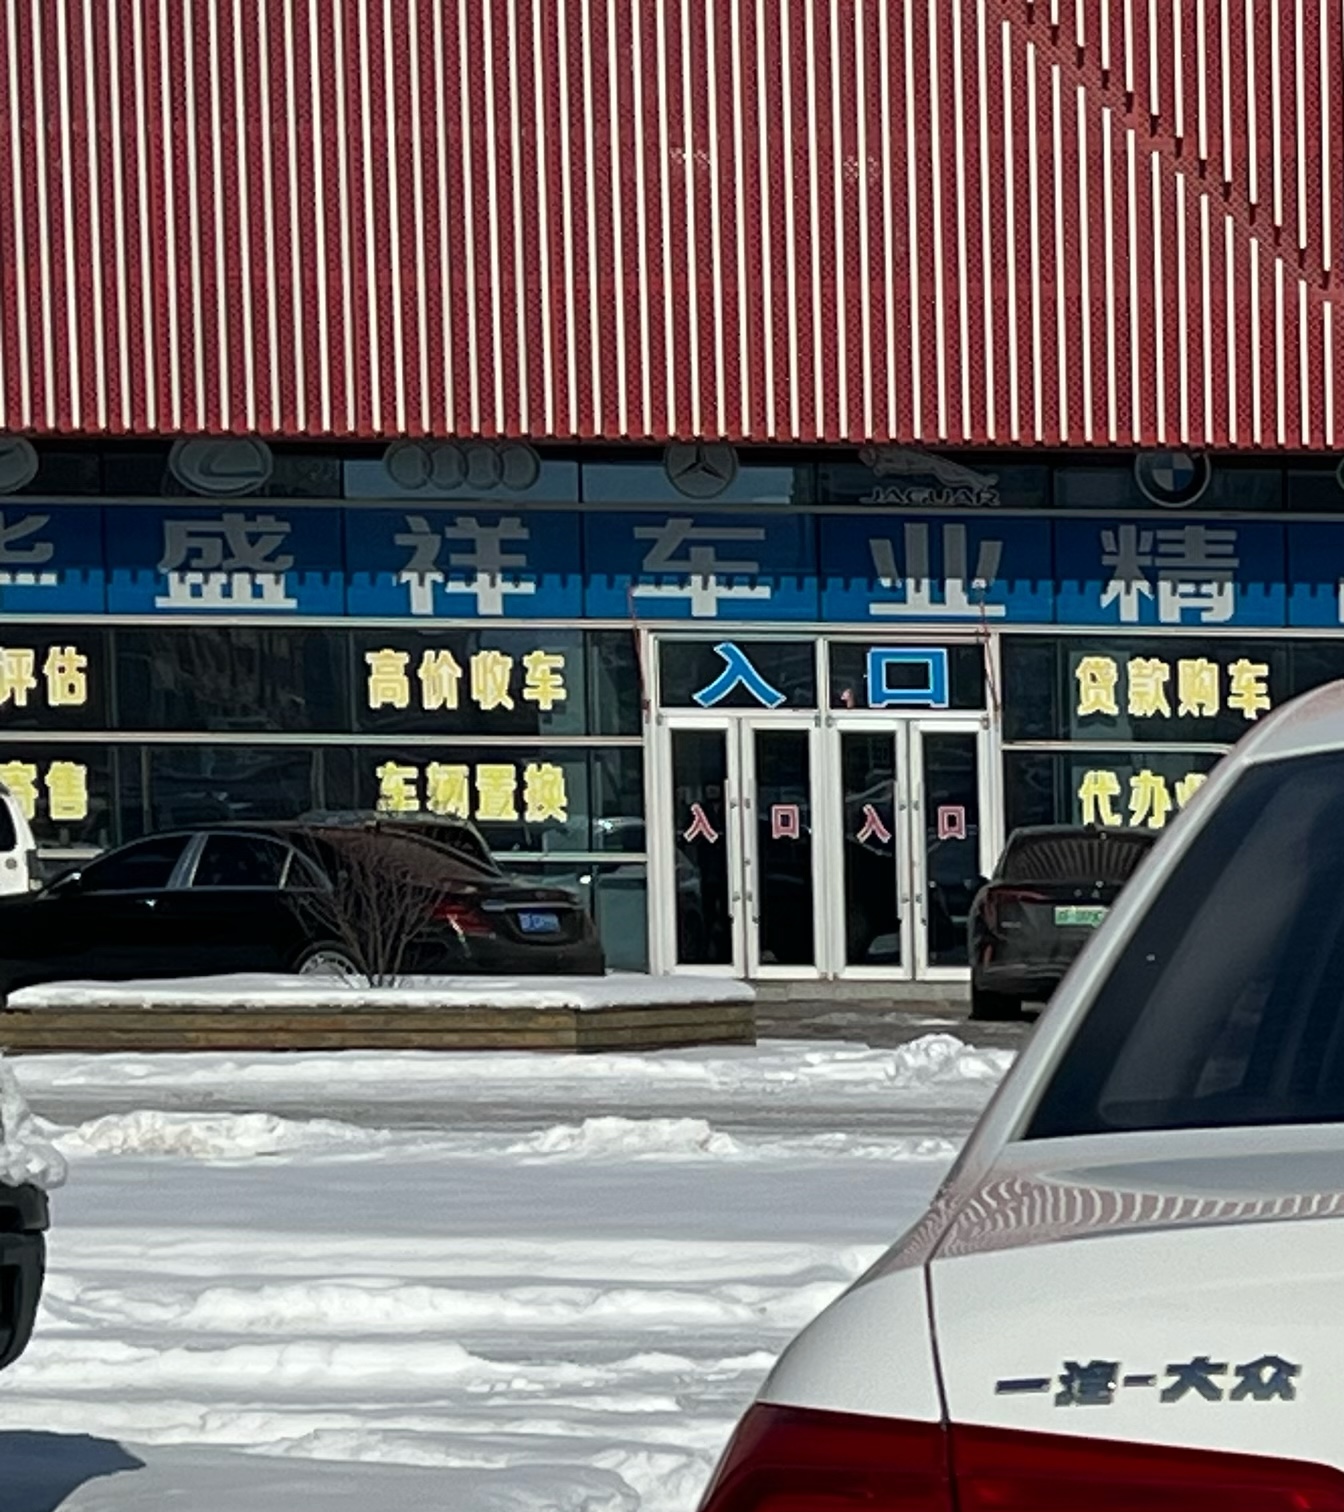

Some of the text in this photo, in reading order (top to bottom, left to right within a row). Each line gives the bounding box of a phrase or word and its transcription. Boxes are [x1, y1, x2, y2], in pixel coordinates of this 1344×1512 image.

[859, 486, 1000, 505] JAGUAR
[365, 649, 567, 710] 高价收车
[693, 641, 951, 708] 入口
[1075, 656, 1271, 720] 贷款购车
[376, 761, 568, 823] 车辆置换
